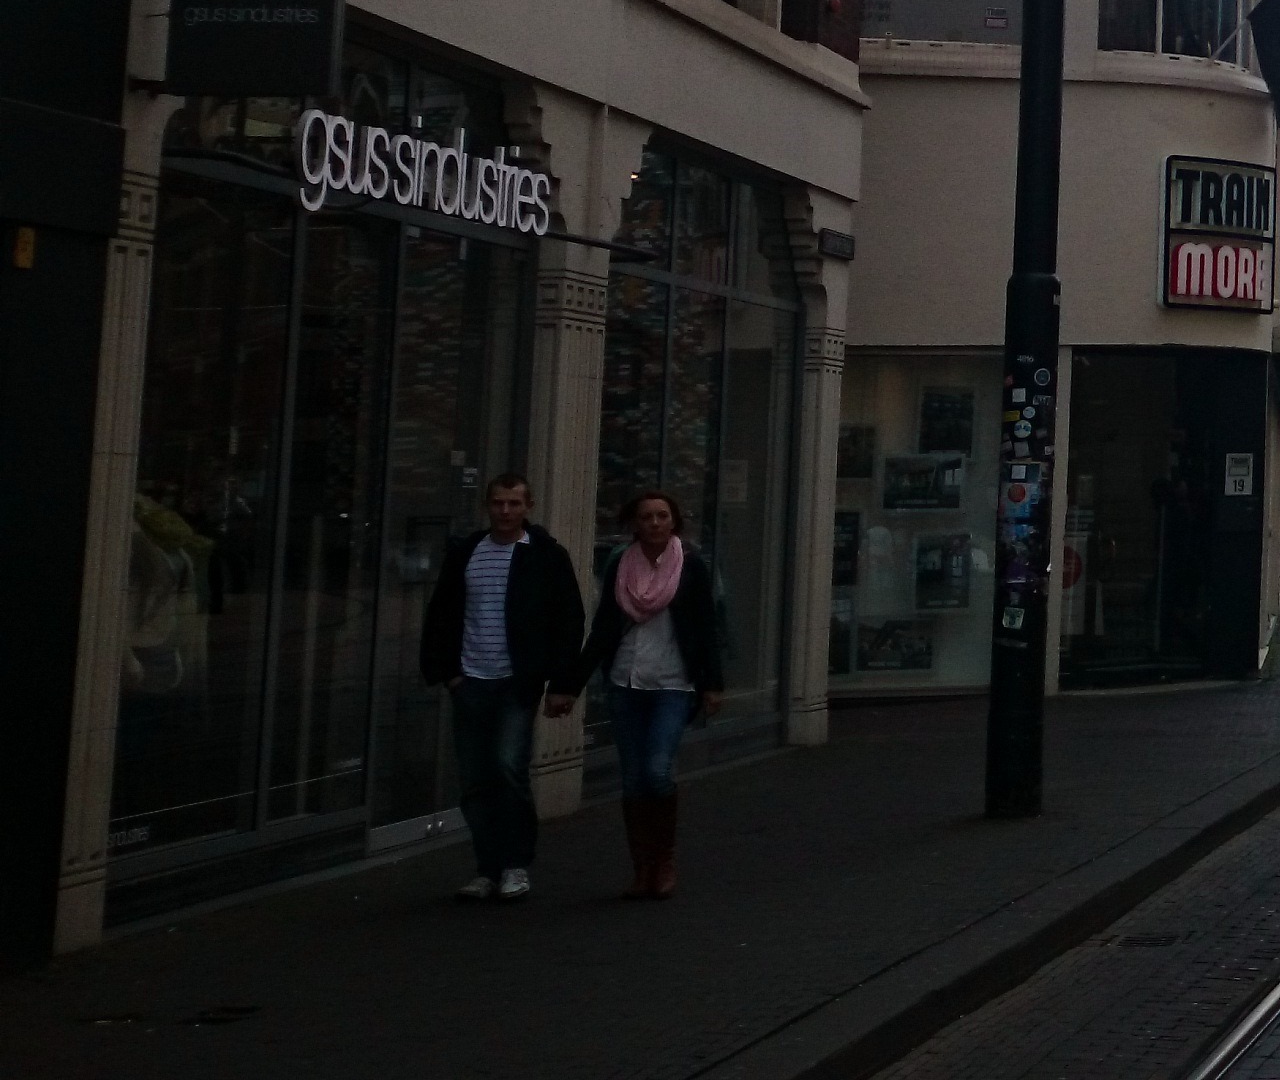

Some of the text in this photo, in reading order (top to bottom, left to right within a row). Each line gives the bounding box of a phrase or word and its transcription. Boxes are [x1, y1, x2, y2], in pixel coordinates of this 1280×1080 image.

[300, 108, 551, 236] gsus sindustries
[1176, 169, 1270, 231] TRAIN
[1172, 241, 1266, 301] MORE
[1233, 479, 1245, 492] 19
